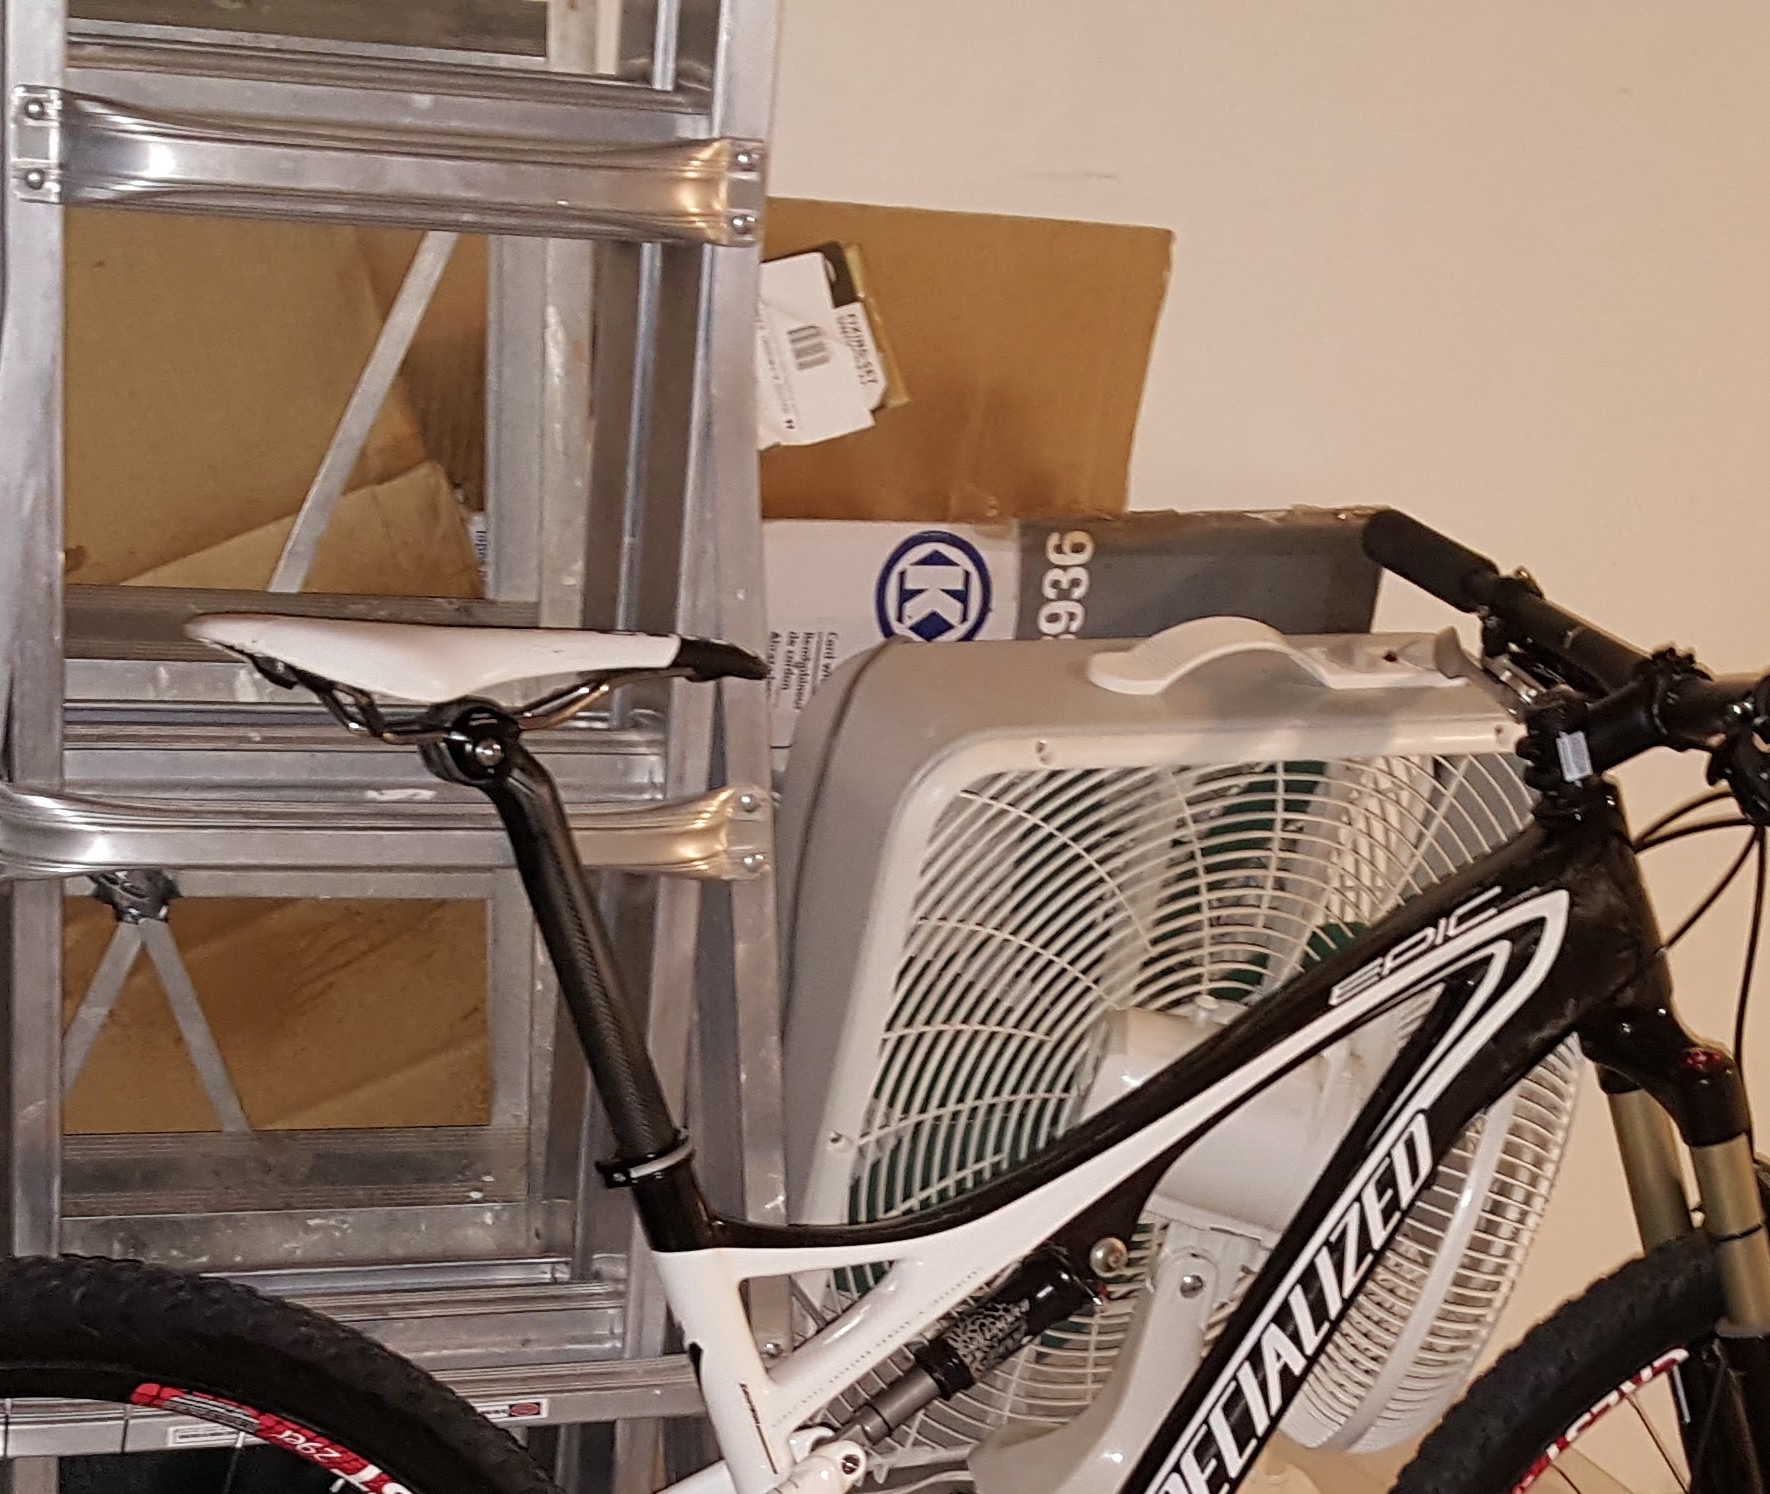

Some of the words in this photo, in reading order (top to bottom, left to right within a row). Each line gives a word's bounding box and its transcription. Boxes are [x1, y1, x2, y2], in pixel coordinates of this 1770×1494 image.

[1036, 531, 1095, 640] 936
[1329, 886, 1502, 1006] EPIC
[272, 1429, 342, 1462] 29er
